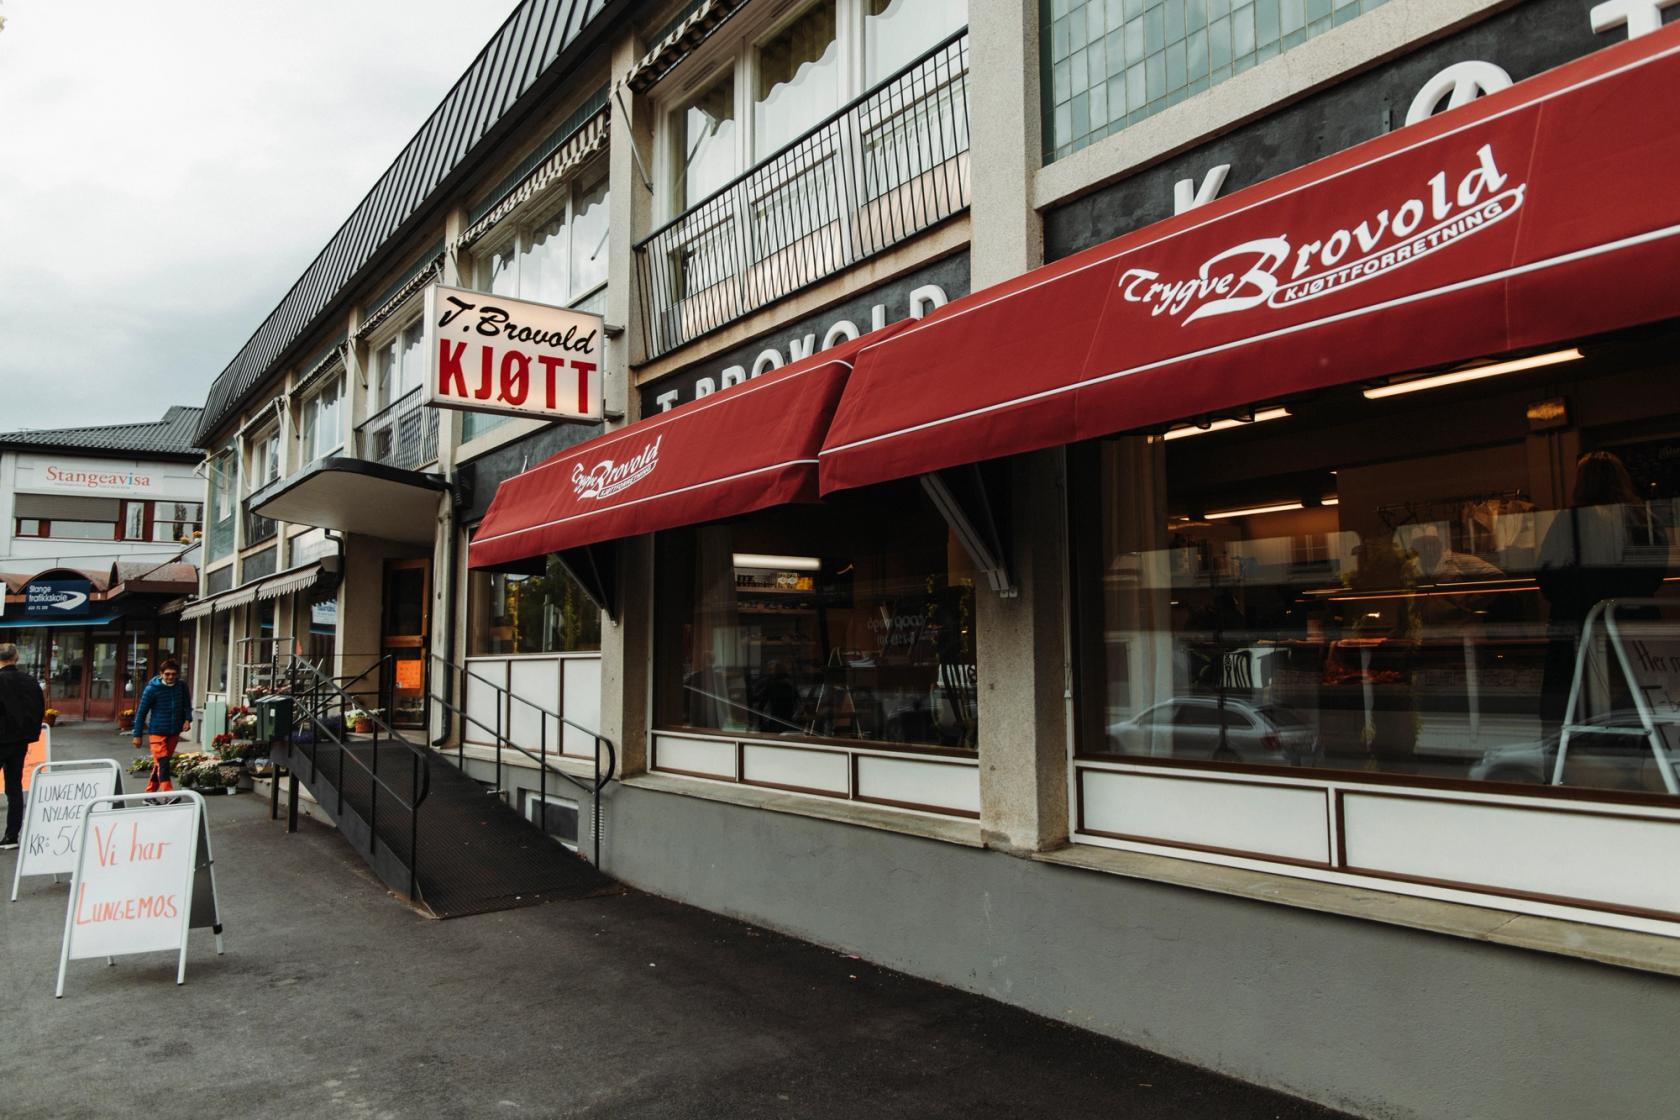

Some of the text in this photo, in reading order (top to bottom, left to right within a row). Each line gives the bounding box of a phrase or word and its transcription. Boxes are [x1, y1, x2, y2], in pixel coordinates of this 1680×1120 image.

[1118, 268, 1235, 317] Trygve
[1182, 143, 1508, 327] Brovold
[1284, 200, 1503, 302] KJØTTFORRETNING
[438, 338, 597, 414] KJØTT
[46, 465, 150, 488] Stangeavisa
[577, 434, 663, 502] Brovold
[29, 585, 52, 594] Stange
[38, 782, 100, 804] LUNGEMOS
[95, 822, 172, 867] Vi har
